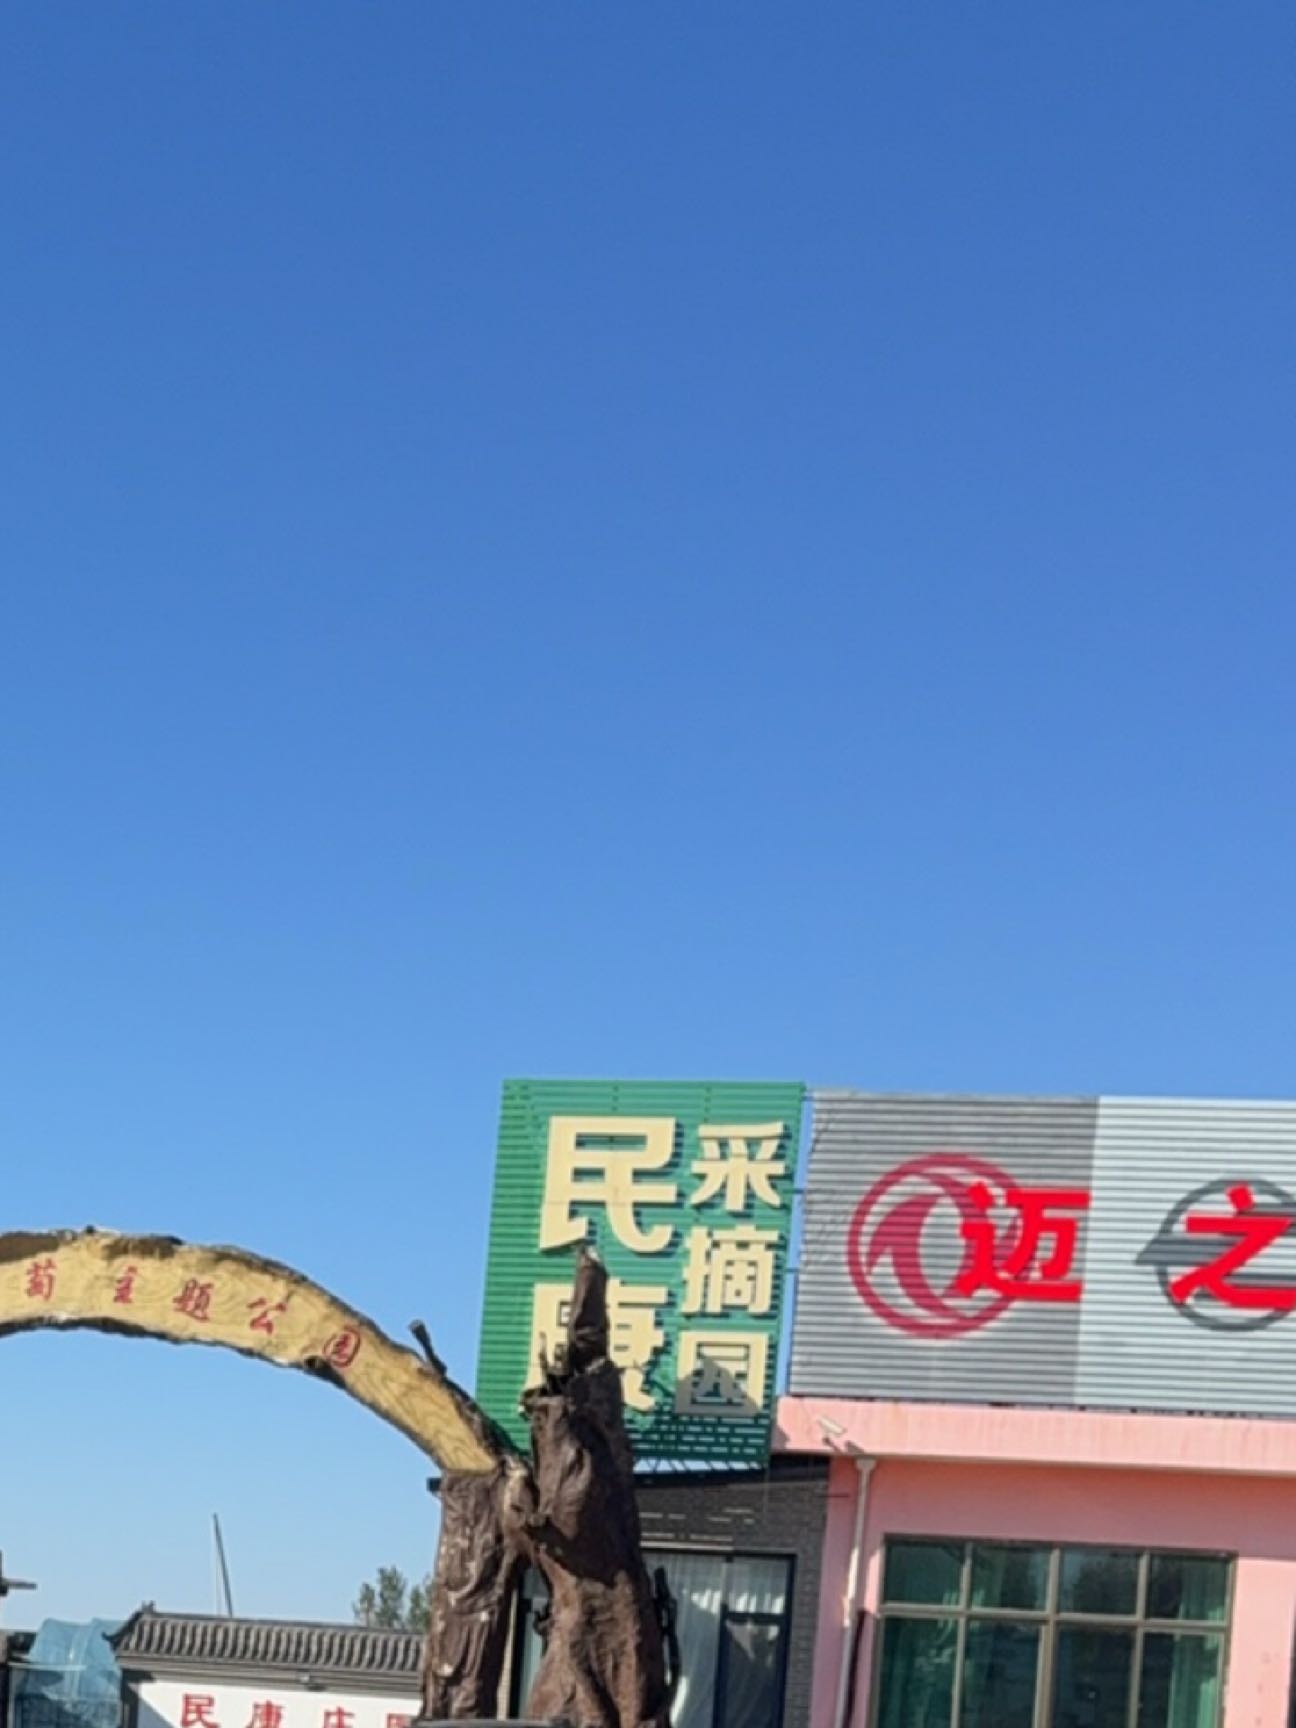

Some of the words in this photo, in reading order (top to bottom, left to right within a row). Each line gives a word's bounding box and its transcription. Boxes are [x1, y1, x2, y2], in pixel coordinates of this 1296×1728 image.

[672, 1121, 786, 1416] 采摘园
[954, 1180, 1296, 1310] 迈之
